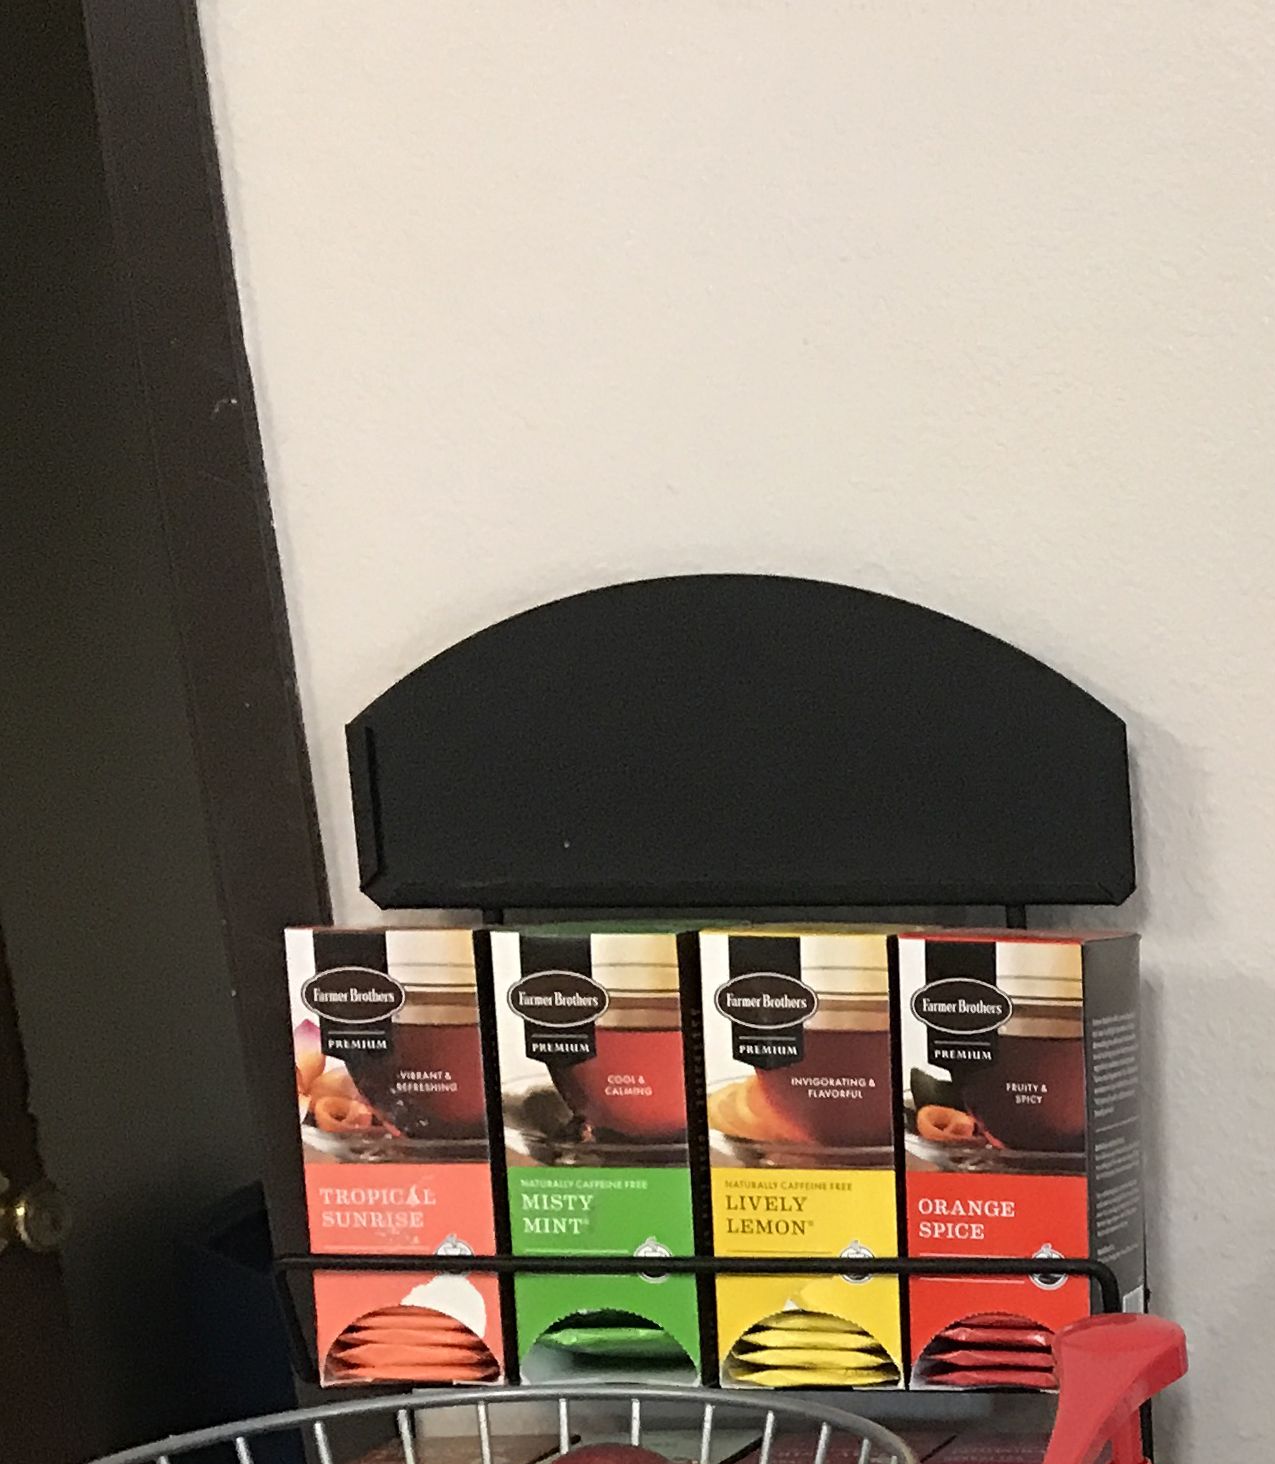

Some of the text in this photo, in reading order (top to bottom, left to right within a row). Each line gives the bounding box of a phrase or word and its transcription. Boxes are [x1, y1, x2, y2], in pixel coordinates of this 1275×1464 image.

[350, 988, 395, 1003] Brothers
[518, 991, 599, 1007] Farmer Brothers
[726, 993, 807, 1009] Farmer Brothers
[922, 998, 1003, 1015] Farmer Brothers
[328, 1039, 387, 1050] PREMIUM
[532, 1043, 590, 1053] PREMIUM
[738, 1045, 798, 1056] PREMIUM
[934, 1050, 992, 1061] PREMIUM
[400, 1071, 443, 1080] VIBRANT
[607, 1075, 635, 1085] COOL
[791, 1077, 866, 1088] INVIGORATING
[1006, 1083, 1038, 1093] FRUITY
[604, 1088, 653, 1096] CALMING
[808, 1089, 863, 1099] FLAVORFUL
[1015, 1095, 1043, 1105] SPICY
[520, 1179, 648, 1190] NATURALLY CAFFEINE FREE
[725, 1180, 853, 1191] NATURALLY CAFFEINE FREE
[319, 1187, 436, 1206] TROPICAL
[521, 1193, 594, 1211] MISTY
[725, 1195, 807, 1212] LIVELY
[918, 1198, 1015, 1217] ORANGE
[322, 1211, 424, 1228] SUNRISE
[919, 1222, 985, 1239] SPICE
